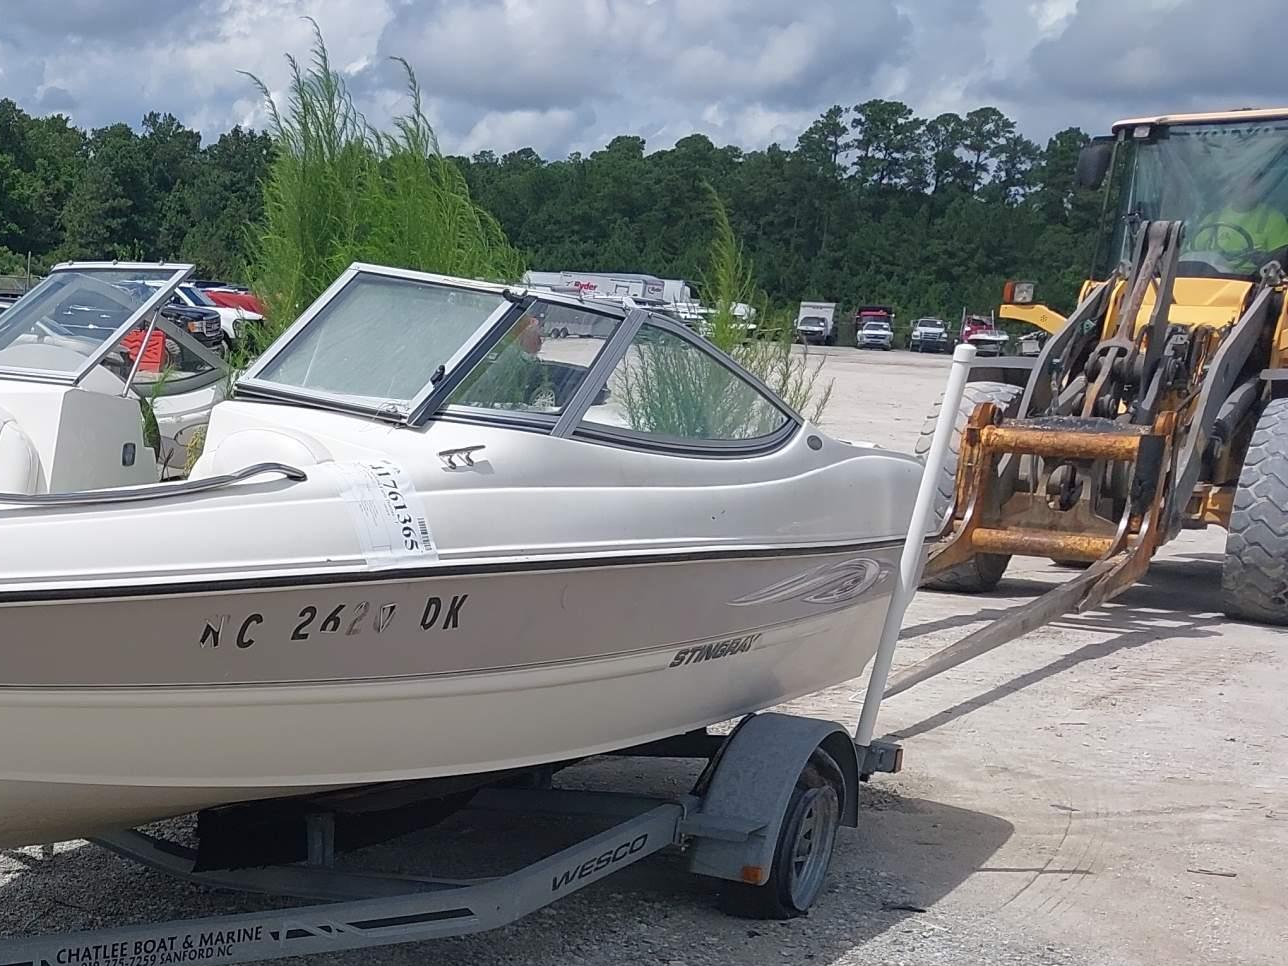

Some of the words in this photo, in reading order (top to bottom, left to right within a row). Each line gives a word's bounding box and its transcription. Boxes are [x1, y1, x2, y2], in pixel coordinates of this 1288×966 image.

[574, 281, 598, 291] Ryder
[200, 613, 263, 649] NC
[420, 594, 469, 631] DK
[669, 632, 762, 668] STINGRAY
[552, 833, 649, 891] WESCO
[56, 941, 129, 965] CHATLEE
[134, 936, 177, 956] BOAT
[182, 934, 194, 949] &
[199, 926, 264, 948] MARINE
[159, 947, 214, 965] SANFORD
[216, 944, 234, 957] NC
